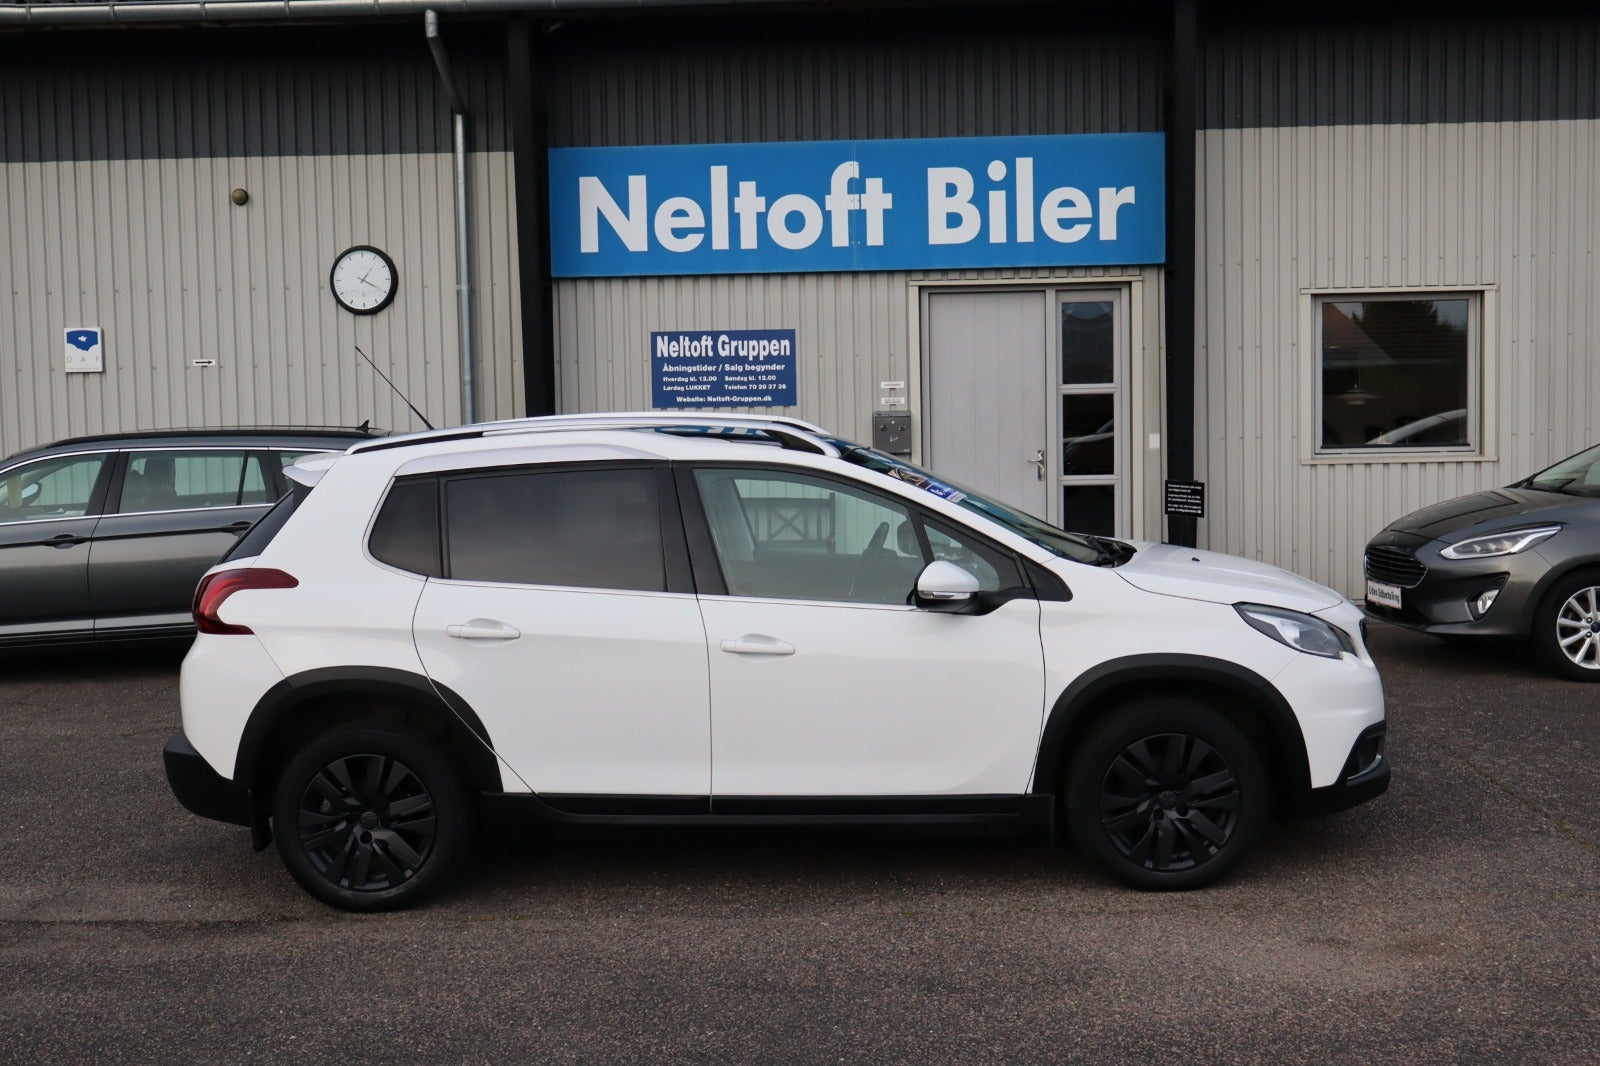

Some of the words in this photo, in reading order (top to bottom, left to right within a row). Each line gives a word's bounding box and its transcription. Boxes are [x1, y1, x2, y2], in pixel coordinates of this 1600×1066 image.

[579, 161, 892, 253] Neltoft
[927, 157, 1136, 245] Biler
[656, 335, 713, 357] Neltoft
[718, 335, 790, 361] Gruppen
[663, 363, 717, 372] Åbningstider
[724, 364, 743, 372] Salg
[745, 363, 785, 372] begynder
[707, 395, 772, 403] Neltoft-Gruppen.dk
